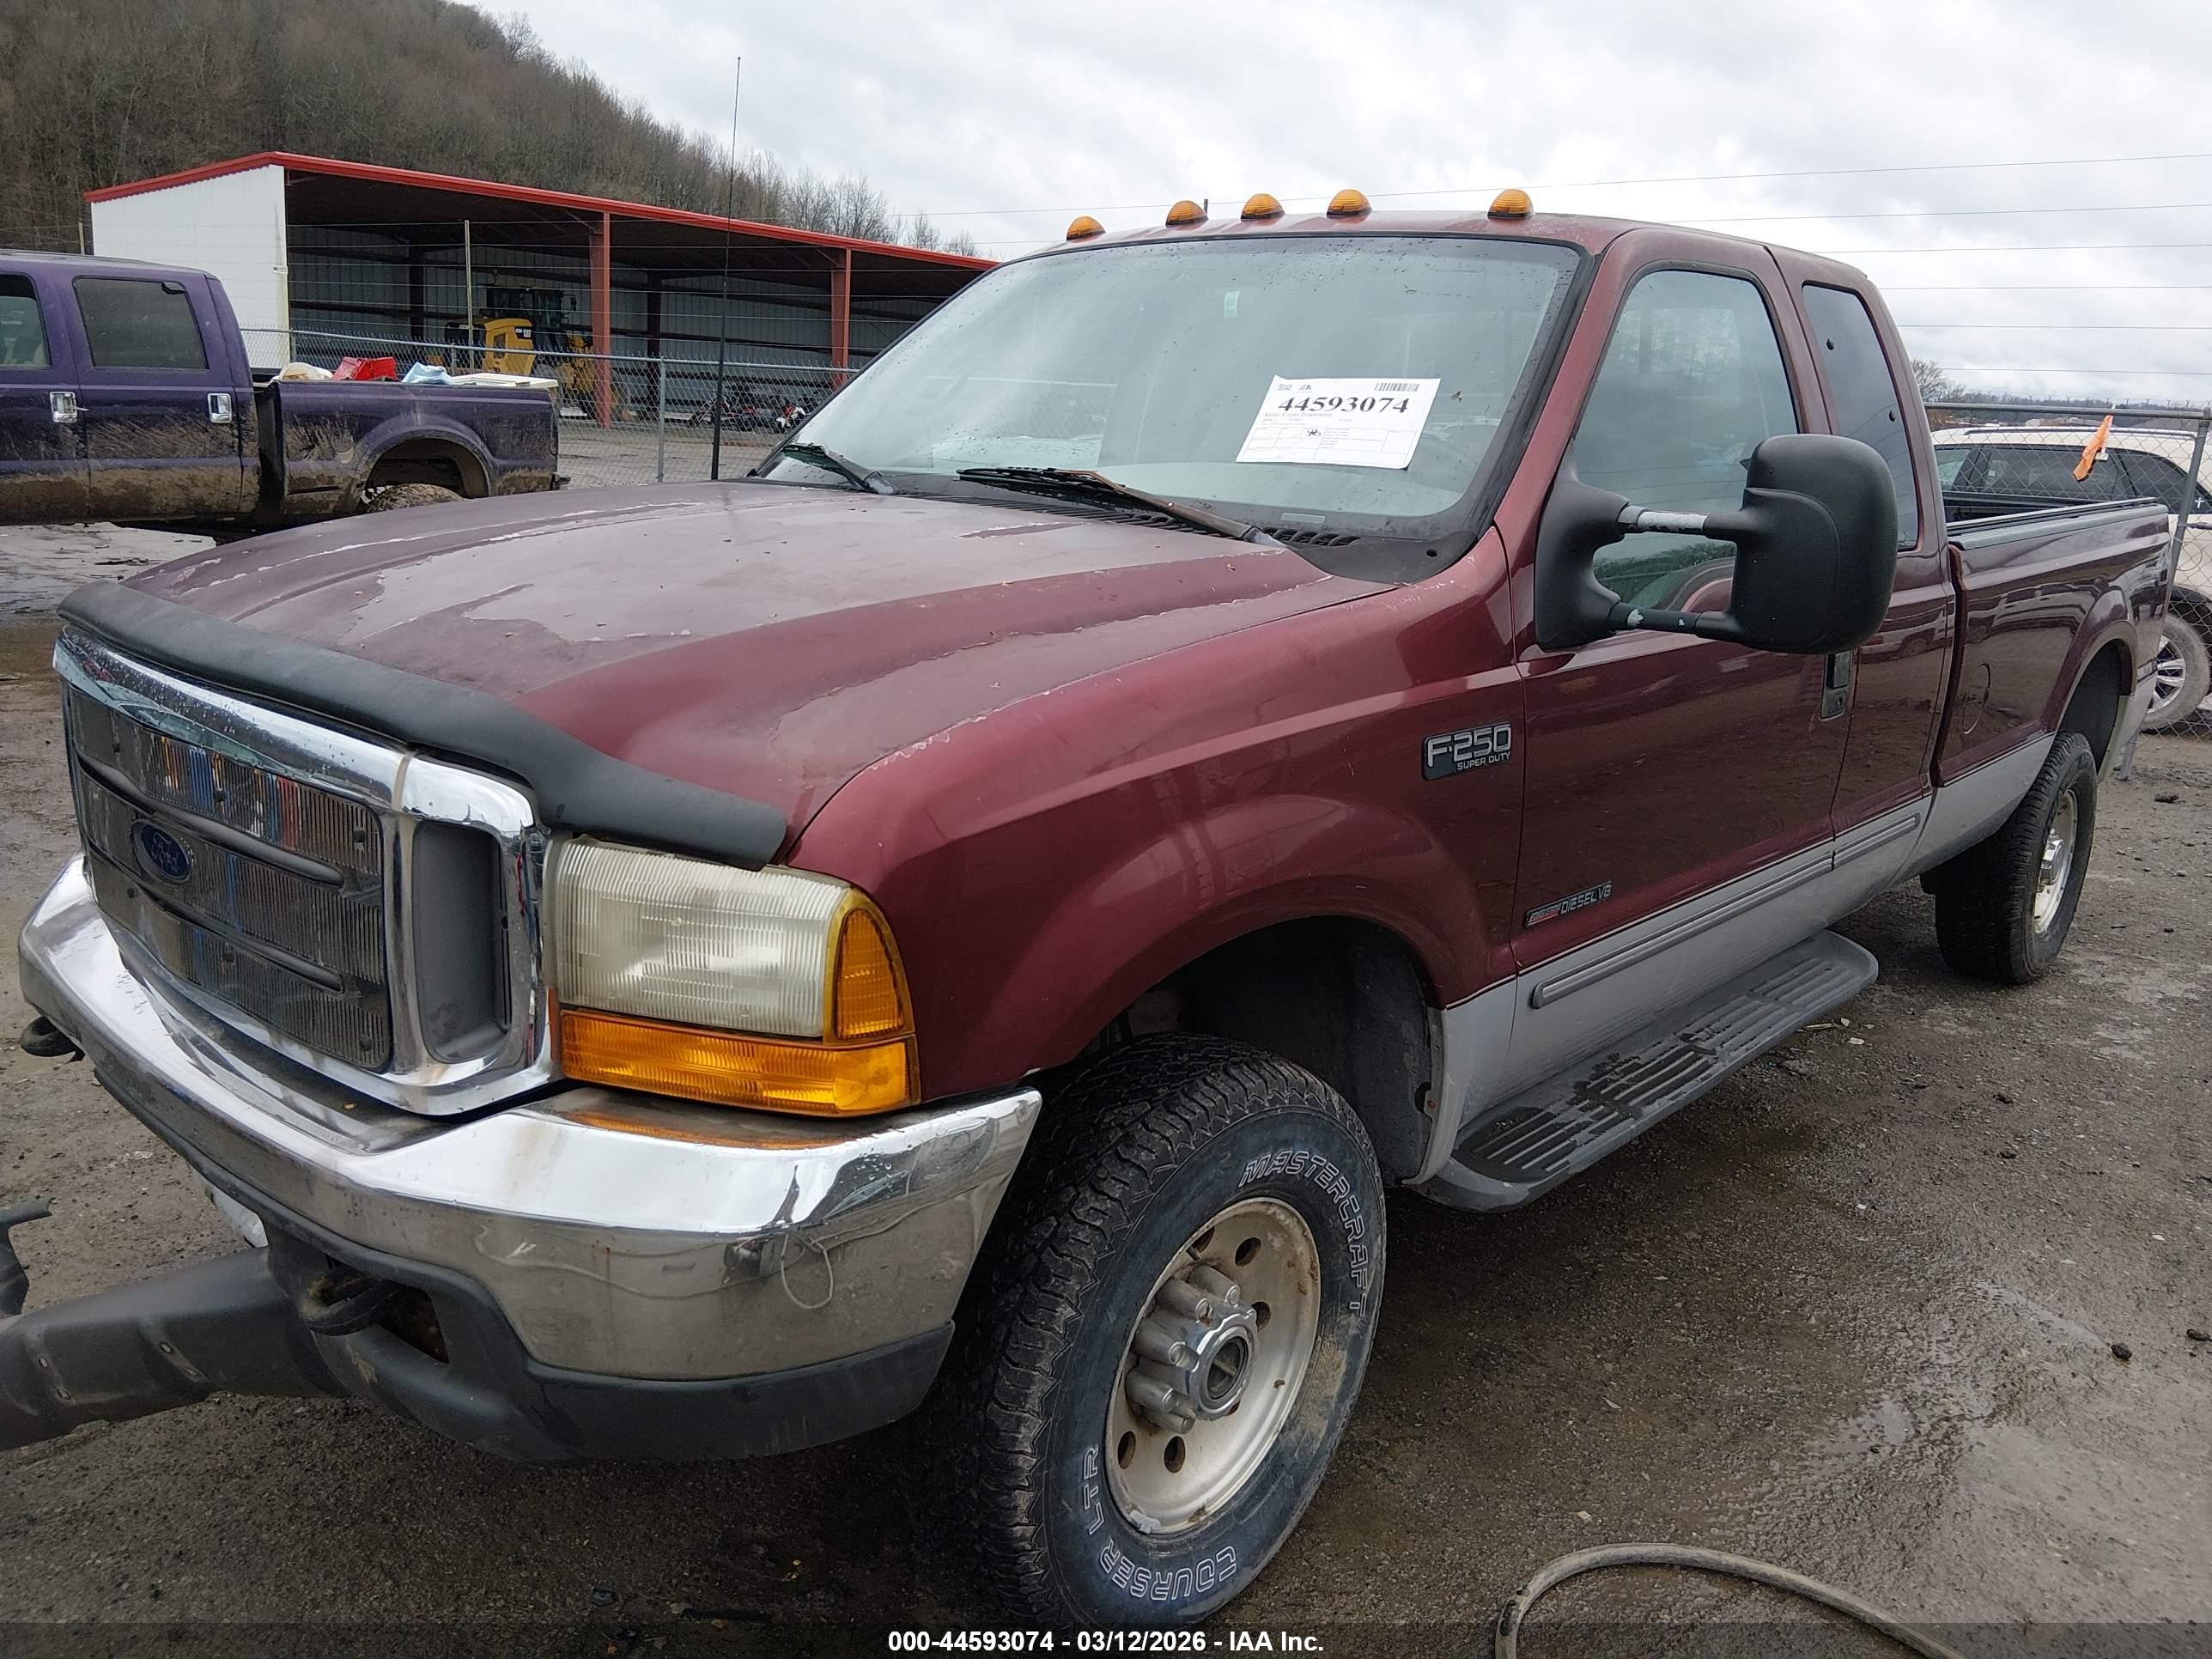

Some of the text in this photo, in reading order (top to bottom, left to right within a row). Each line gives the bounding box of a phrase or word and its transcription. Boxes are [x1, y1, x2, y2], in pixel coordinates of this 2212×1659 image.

[1278, 396, 1410, 413] 44593074
[1457, 750, 1511, 770] SUPER DUTY
[1560, 890, 1597, 915] DIESEL
[1238, 1147, 1369, 1317] MASTERCRAFT
[1084, 1444, 1237, 1601] COURSER LTR
